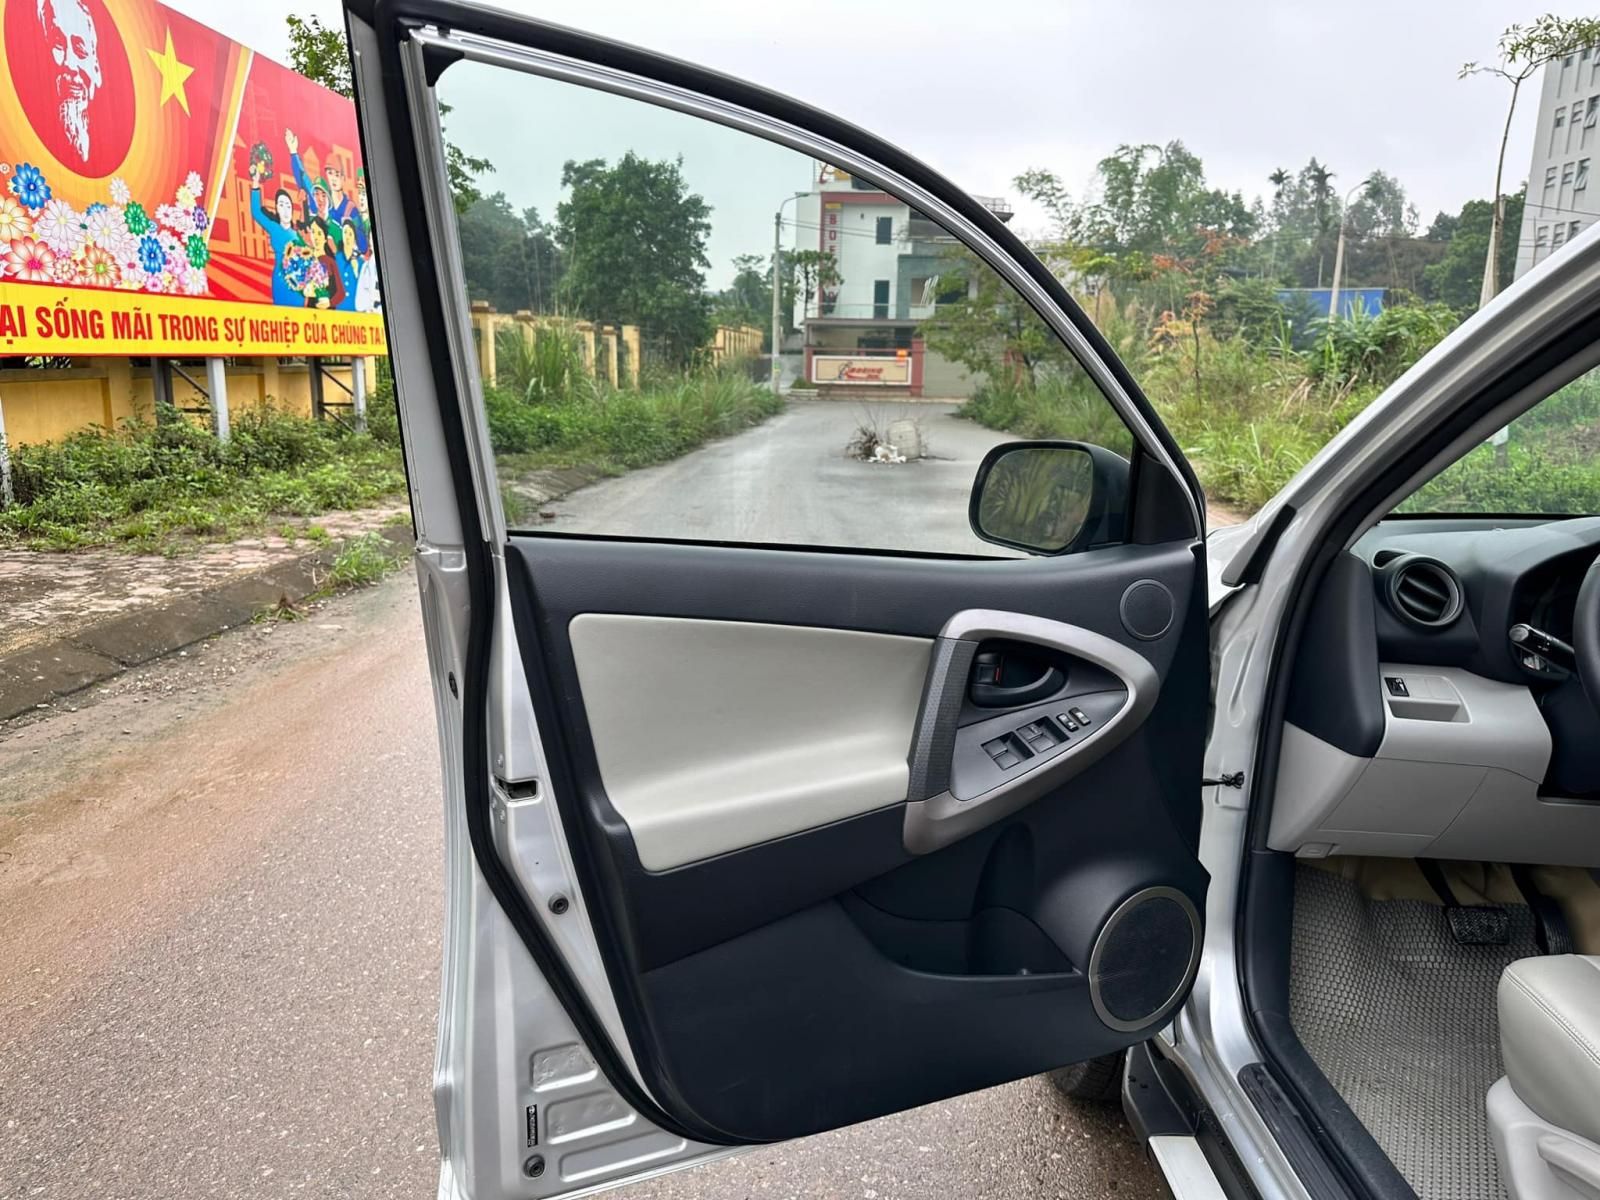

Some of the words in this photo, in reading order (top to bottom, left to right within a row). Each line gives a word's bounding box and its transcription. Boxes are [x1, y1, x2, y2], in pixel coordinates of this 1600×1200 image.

[35, 297, 104, 339] SỐNG
[111, 307, 153, 340] MÃI
[158, 313, 219, 341] TRONG
[224, 316, 246, 347] SỰ
[249, 316, 299, 348] NGHIỆP
[304, 313, 328, 344] CỦA
[331, 320, 367, 345] CHÚNG
